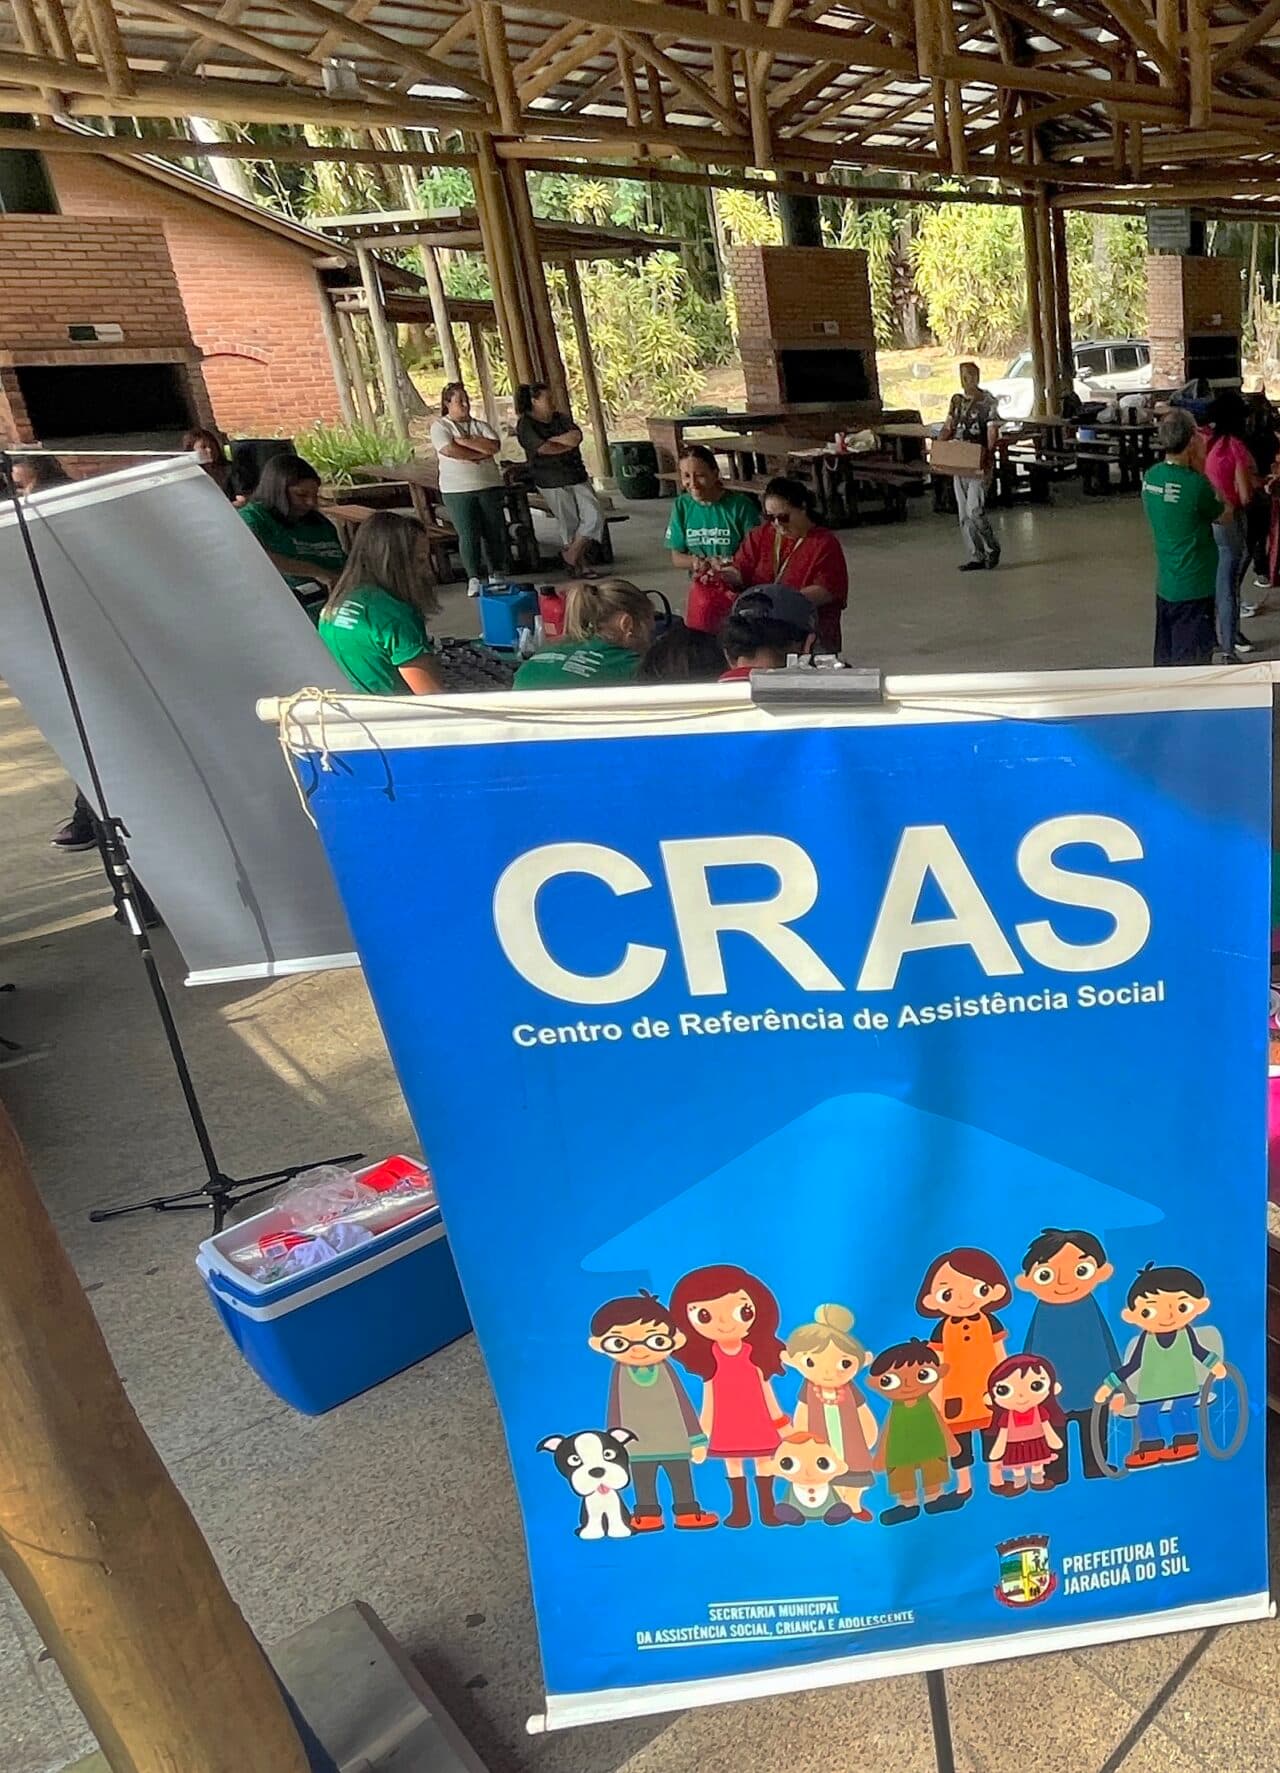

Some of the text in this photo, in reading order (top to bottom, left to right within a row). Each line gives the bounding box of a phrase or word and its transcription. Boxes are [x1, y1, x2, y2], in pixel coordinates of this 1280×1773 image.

[492, 814, 1151, 1004] CRAS
[512, 980, 1166, 1047] Centro de Referência de Assistência Social
[1062, 1536, 1179, 1575] PREFEITURA DE
[1063, 1555, 1191, 1596] JARAGUÁ DO SUL
[636, 1609, 915, 1645] DA ASSISTÊNCIA SOCIAL, CRIANÇA E ADOLESCENTE
[709, 1601, 841, 1622] SECRETARIA MUNICIPAL
